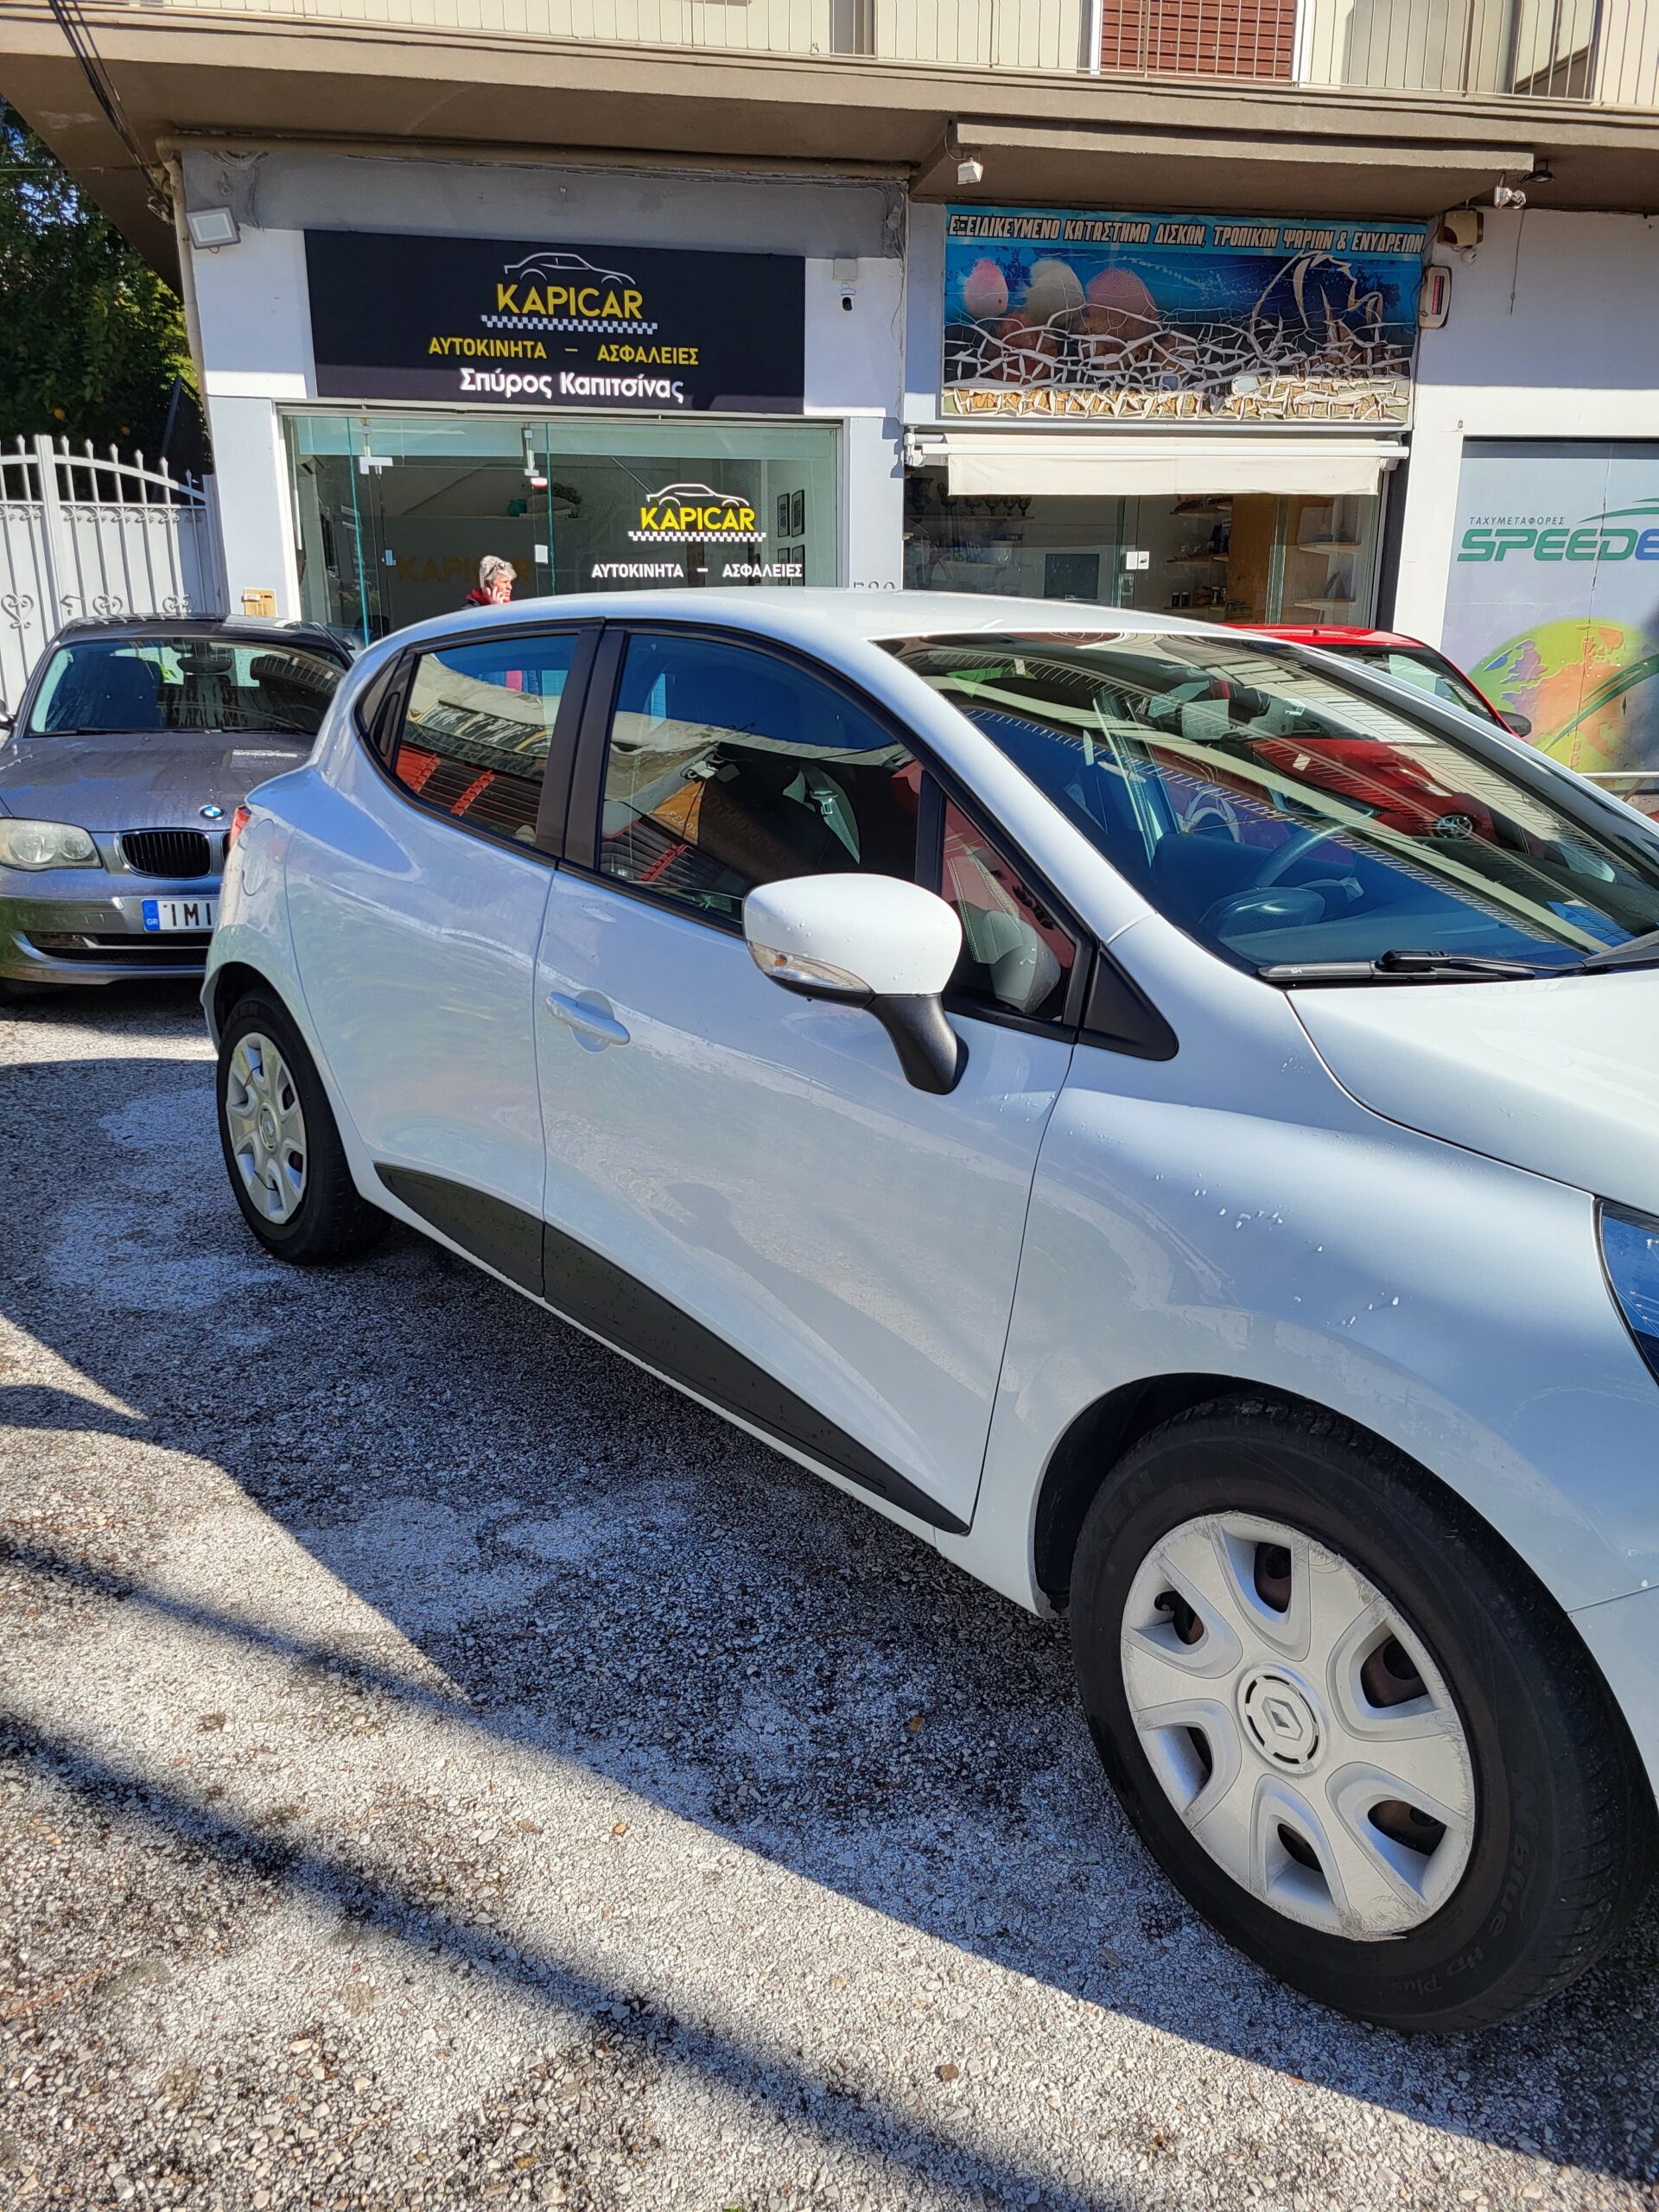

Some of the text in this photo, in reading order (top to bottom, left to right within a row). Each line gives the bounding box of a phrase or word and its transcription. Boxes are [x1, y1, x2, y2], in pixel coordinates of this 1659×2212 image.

[949, 215, 1425, 254] ΕΞΕΙΔΙΚΕΥΜΕΝΟ ΚΑΤΑΣΤΗΜΑ ΔΙΣΚΩΝ, ΤΡΟΠΙΚΩΝ ΨΑΡΙΩΝ & ΕΝΥΔΡΕΙΩΝ
[497, 283, 643, 320] KAPICAR
[429, 337, 548, 359] ΑΥΤΟΚΙΝΗΤΑ
[597, 344, 699, 365] ΑΣΦΑΛΕΙΕΣ
[460, 367, 683, 404] Σπύρος Καπιτσίνας
[640, 506, 755, 531] KAPICAR
[1470, 517, 1565, 525] ΤΑΧΥΜΕΤΑΦΟΡΕΣ
[591, 563, 683, 578] ΑΥΤΟΚΙΝΗΤΑ
[722, 563, 803, 578] ΑΣΦΑΛΕΙΕΣ
[146, 918, 159, 926] GR
